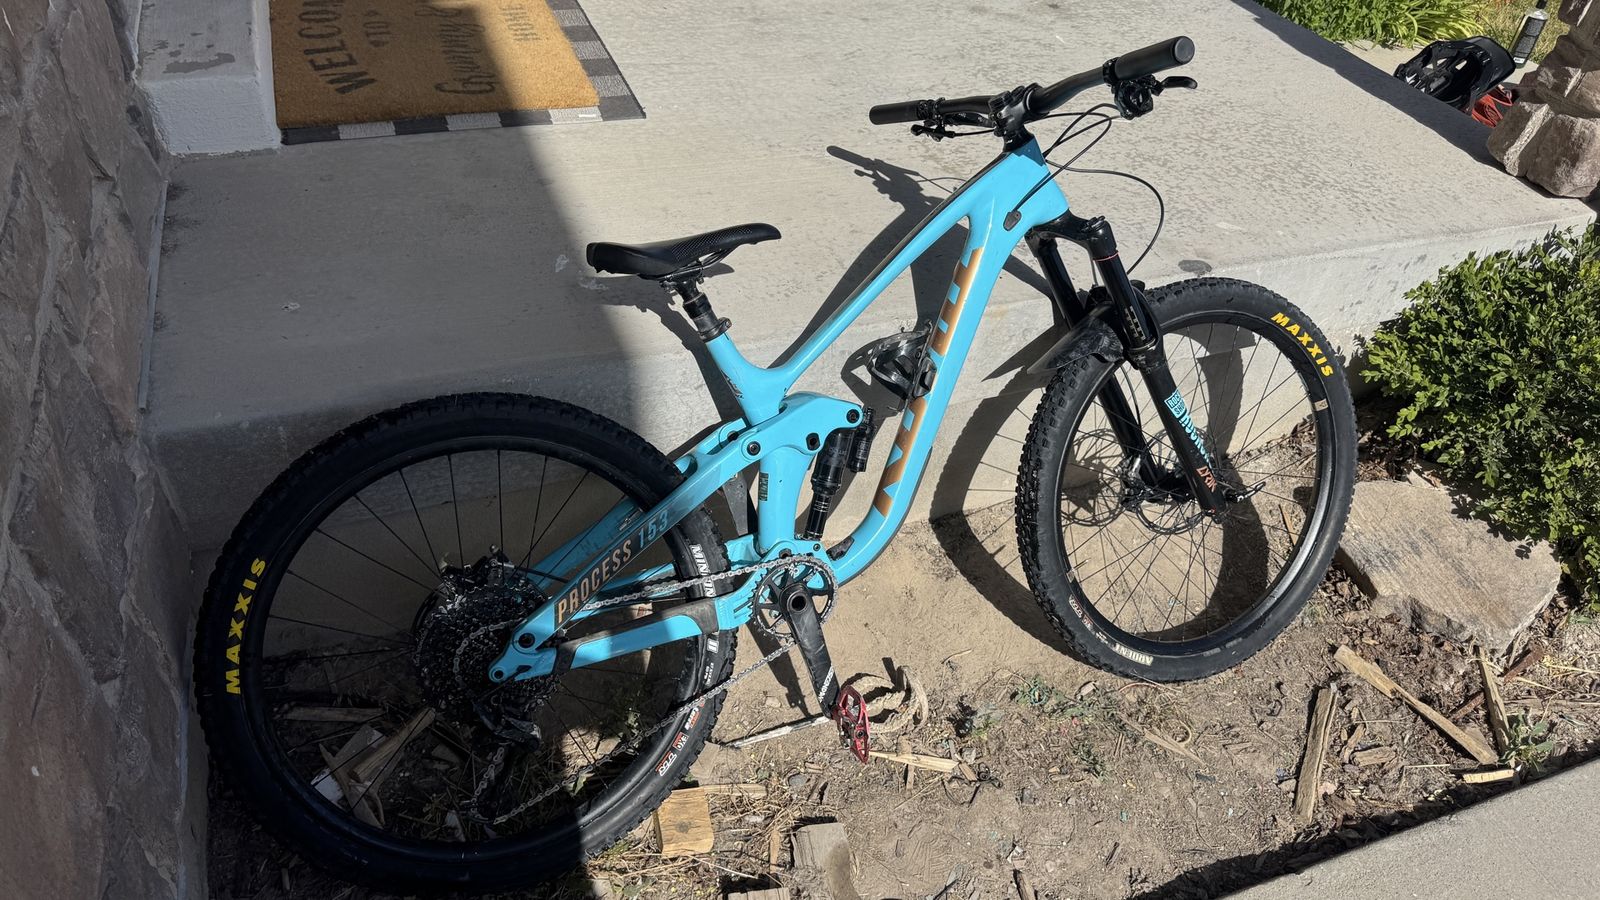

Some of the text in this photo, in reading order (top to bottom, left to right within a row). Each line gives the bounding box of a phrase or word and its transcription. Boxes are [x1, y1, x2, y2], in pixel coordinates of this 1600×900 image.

[363, 21, 391, 38] TO
[1271, 312, 1333, 376] MAXXIS
[1196, 465, 1217, 493] LYRIK
[558, 509, 668, 624] PROCESS 153
[226, 558, 266, 694] MAXXIS
[1112, 643, 1154, 667] ARDENT
